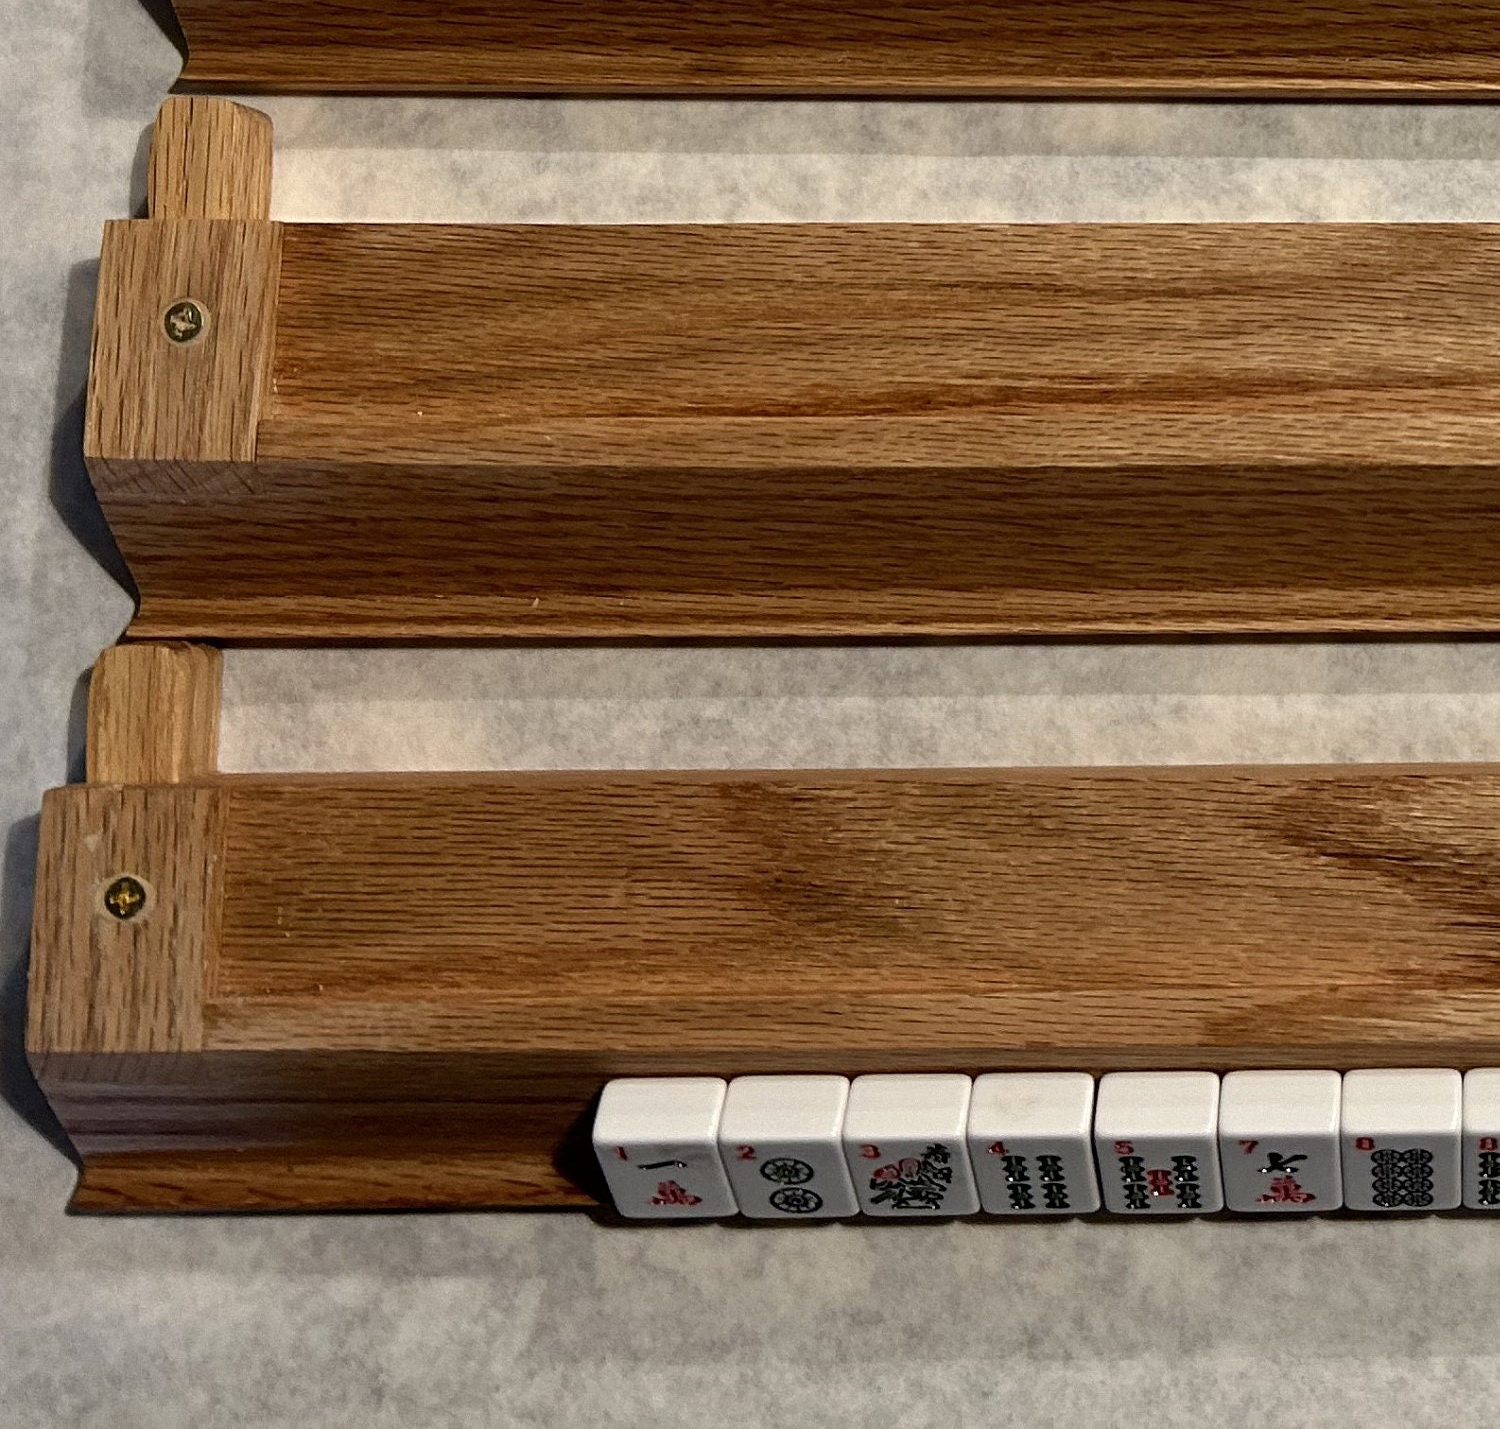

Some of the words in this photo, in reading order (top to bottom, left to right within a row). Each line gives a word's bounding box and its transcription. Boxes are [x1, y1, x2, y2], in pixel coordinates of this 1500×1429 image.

[615, 1145, 628, 1161] 1
[736, 1145, 757, 1161] 2
[860, 1143, 881, 1159] 3
[986, 1140, 1009, 1157] 4
[1114, 1140, 1135, 1156] 5
[1239, 1139, 1259, 1155] 7
